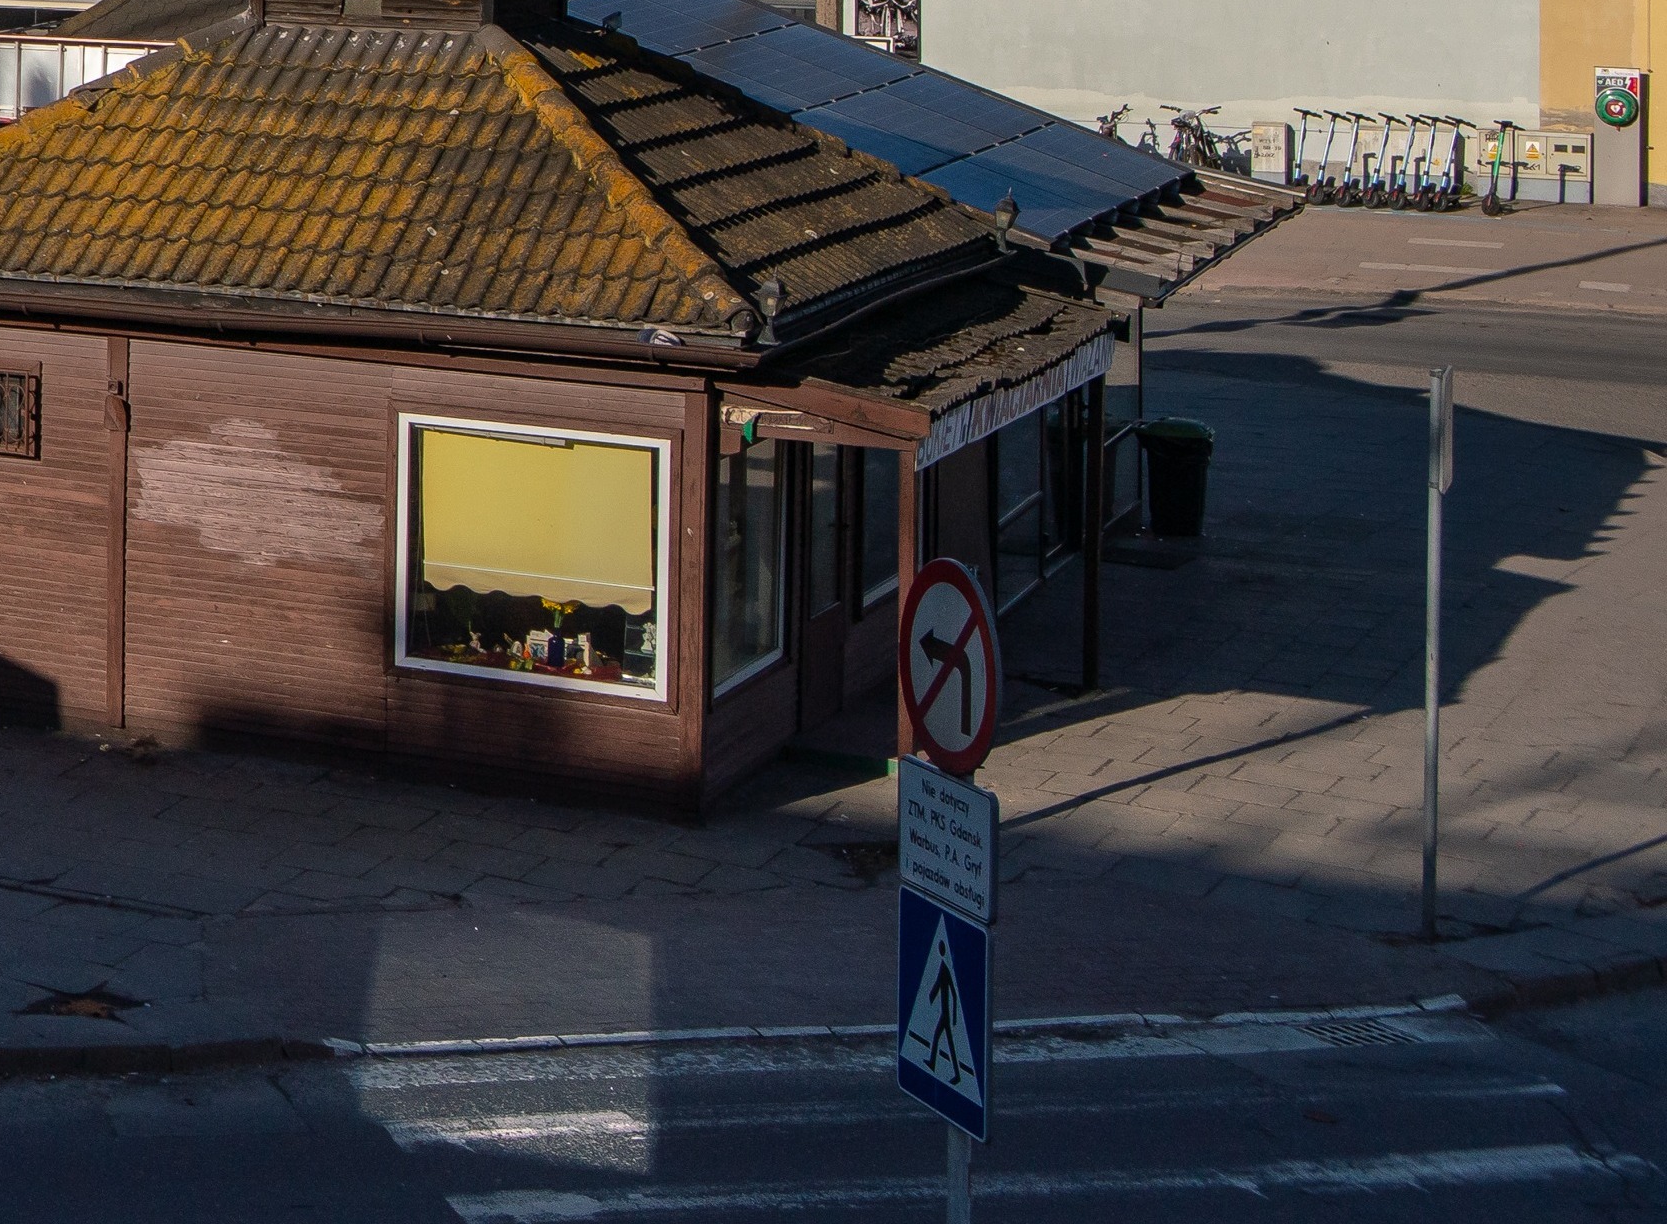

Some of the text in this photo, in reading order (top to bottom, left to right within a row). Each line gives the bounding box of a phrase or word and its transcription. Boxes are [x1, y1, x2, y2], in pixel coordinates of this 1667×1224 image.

[1604, 78, 1624, 86] AED
[921, 778, 970, 818] Nie dotyczy
[907, 798, 984, 850] ZTM, PKS Gdańsk,
[908, 826, 983, 880] Warbus, P.A. Gryf
[912, 860, 986, 911] pojazdów obsługi
